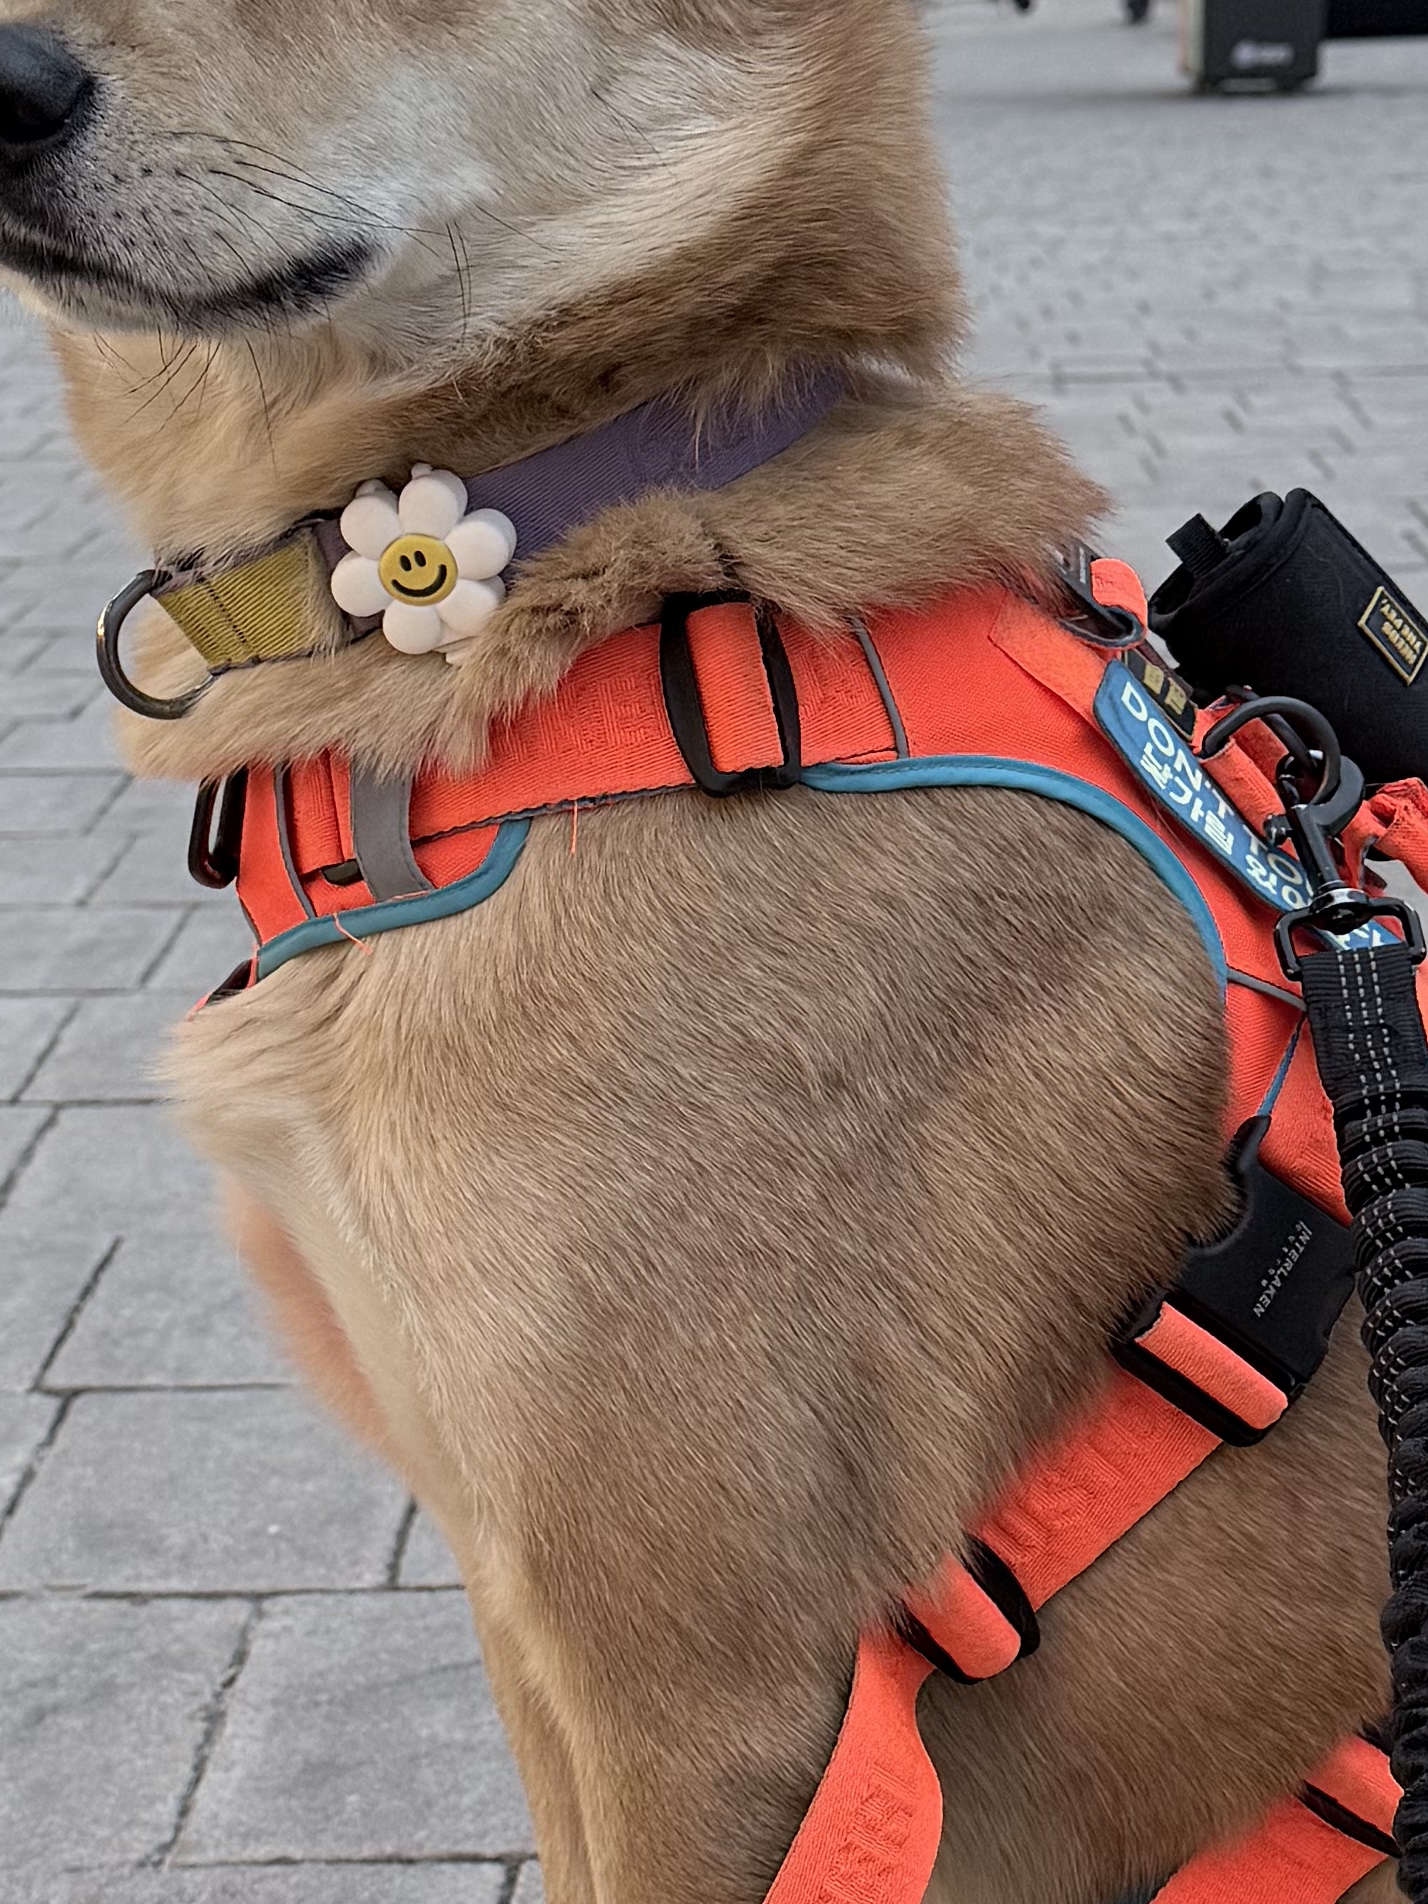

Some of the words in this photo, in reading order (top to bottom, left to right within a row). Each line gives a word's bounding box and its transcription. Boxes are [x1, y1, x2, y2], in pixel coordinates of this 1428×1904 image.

[1119, 680, 1235, 824] DON'T
[1139, 739, 1236, 856] 낯가림
[1252, 1219, 1312, 1318] INTERLAKEN
